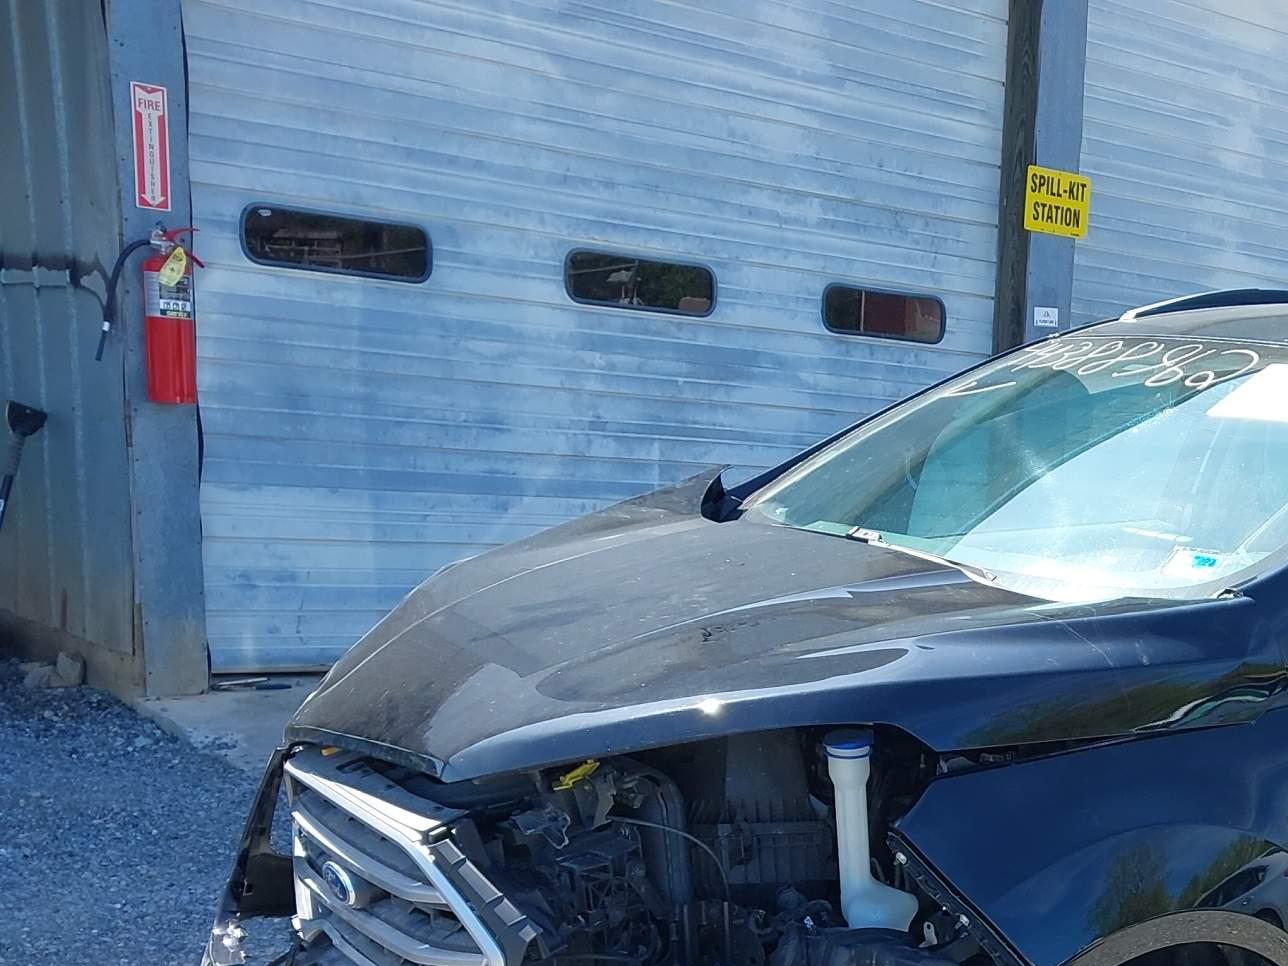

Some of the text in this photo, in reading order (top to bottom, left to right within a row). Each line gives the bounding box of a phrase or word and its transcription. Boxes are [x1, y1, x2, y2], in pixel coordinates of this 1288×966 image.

[138, 98, 161, 112] FIRE
[146, 112, 156, 202] EXTINGUISHER
[1030, 172, 1087, 203] SPILL-KIT
[1032, 202, 1081, 229] STATION
